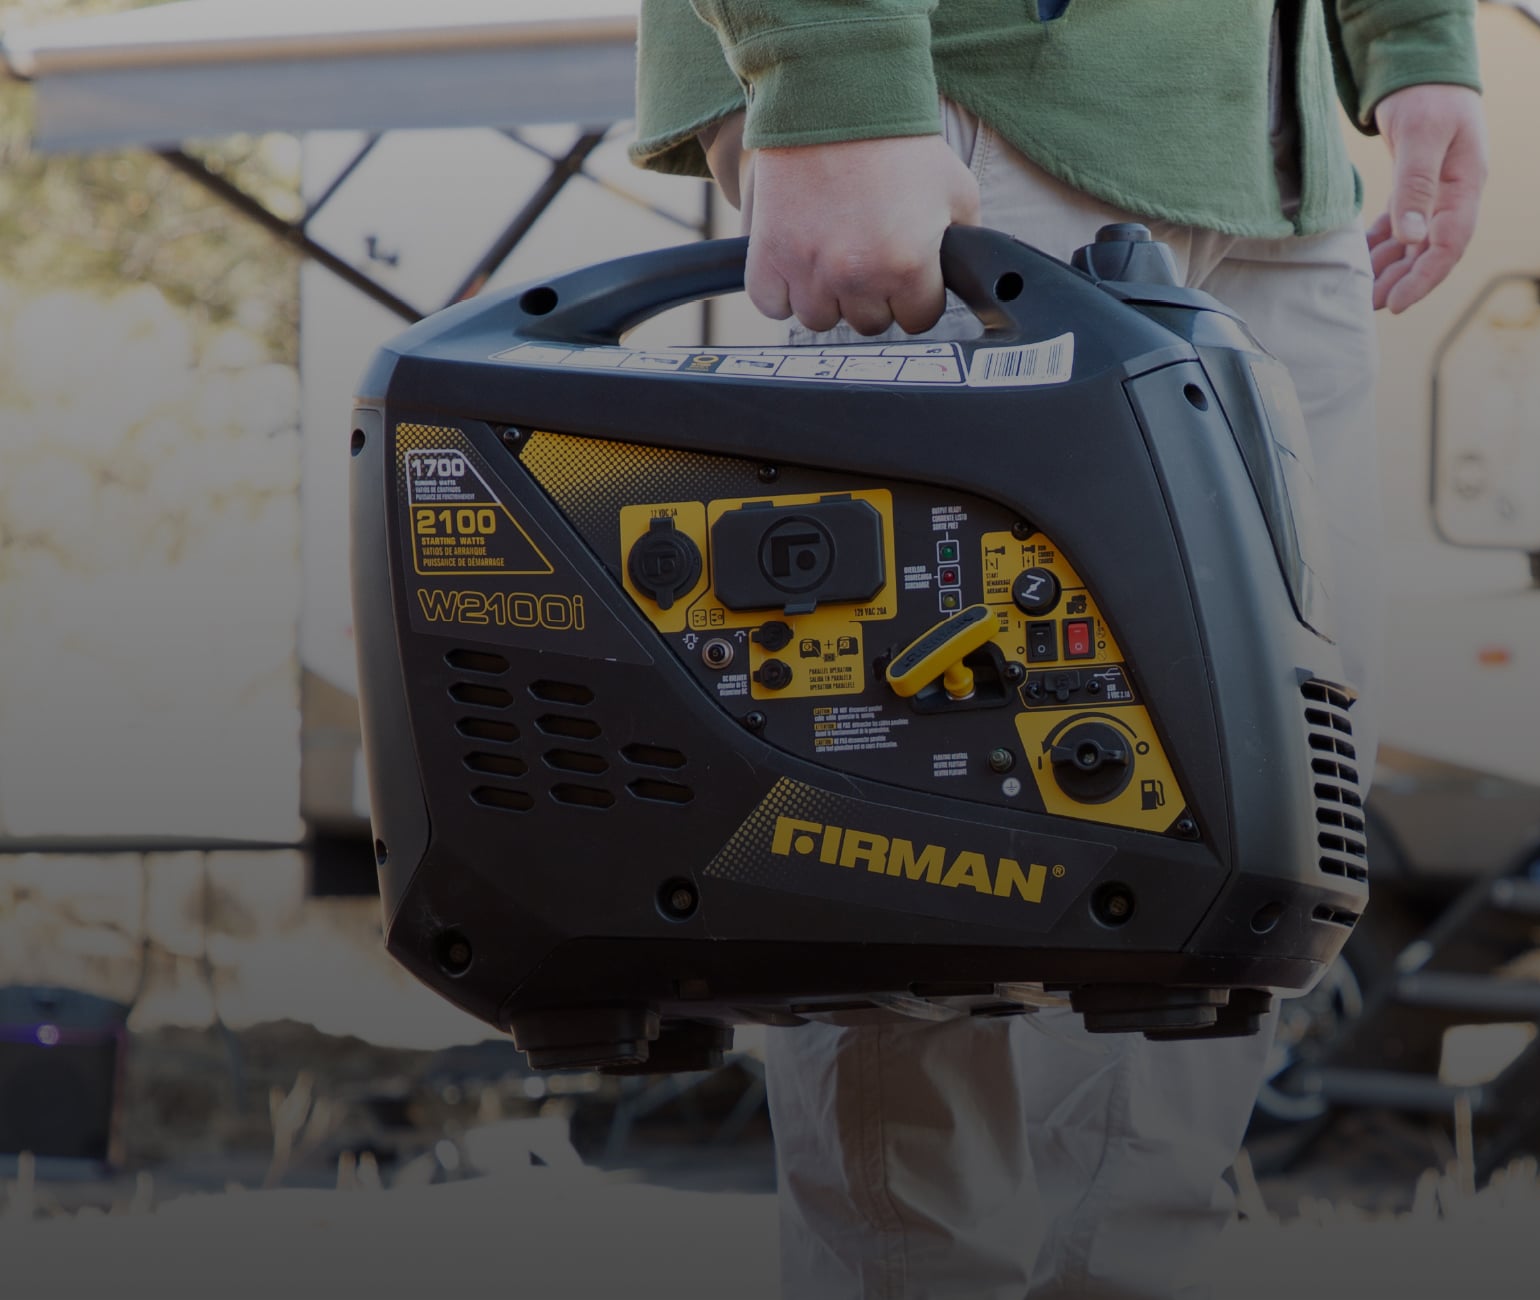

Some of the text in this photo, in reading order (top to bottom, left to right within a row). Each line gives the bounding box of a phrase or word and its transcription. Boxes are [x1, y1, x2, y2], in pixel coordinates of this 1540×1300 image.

[411, 458, 465, 477] 1700
[416, 509, 497, 535] 2100
[421, 536, 485, 545] STARTING WATTS
[422, 546, 443, 556] VATIOS
[444, 546, 453, 556] DE
[423, 557, 456, 567] PUISSANCE
[457, 557, 466, 567] DE
[416, 588, 585, 631] W2100i
[771, 815, 1048, 904] FIRMAN
